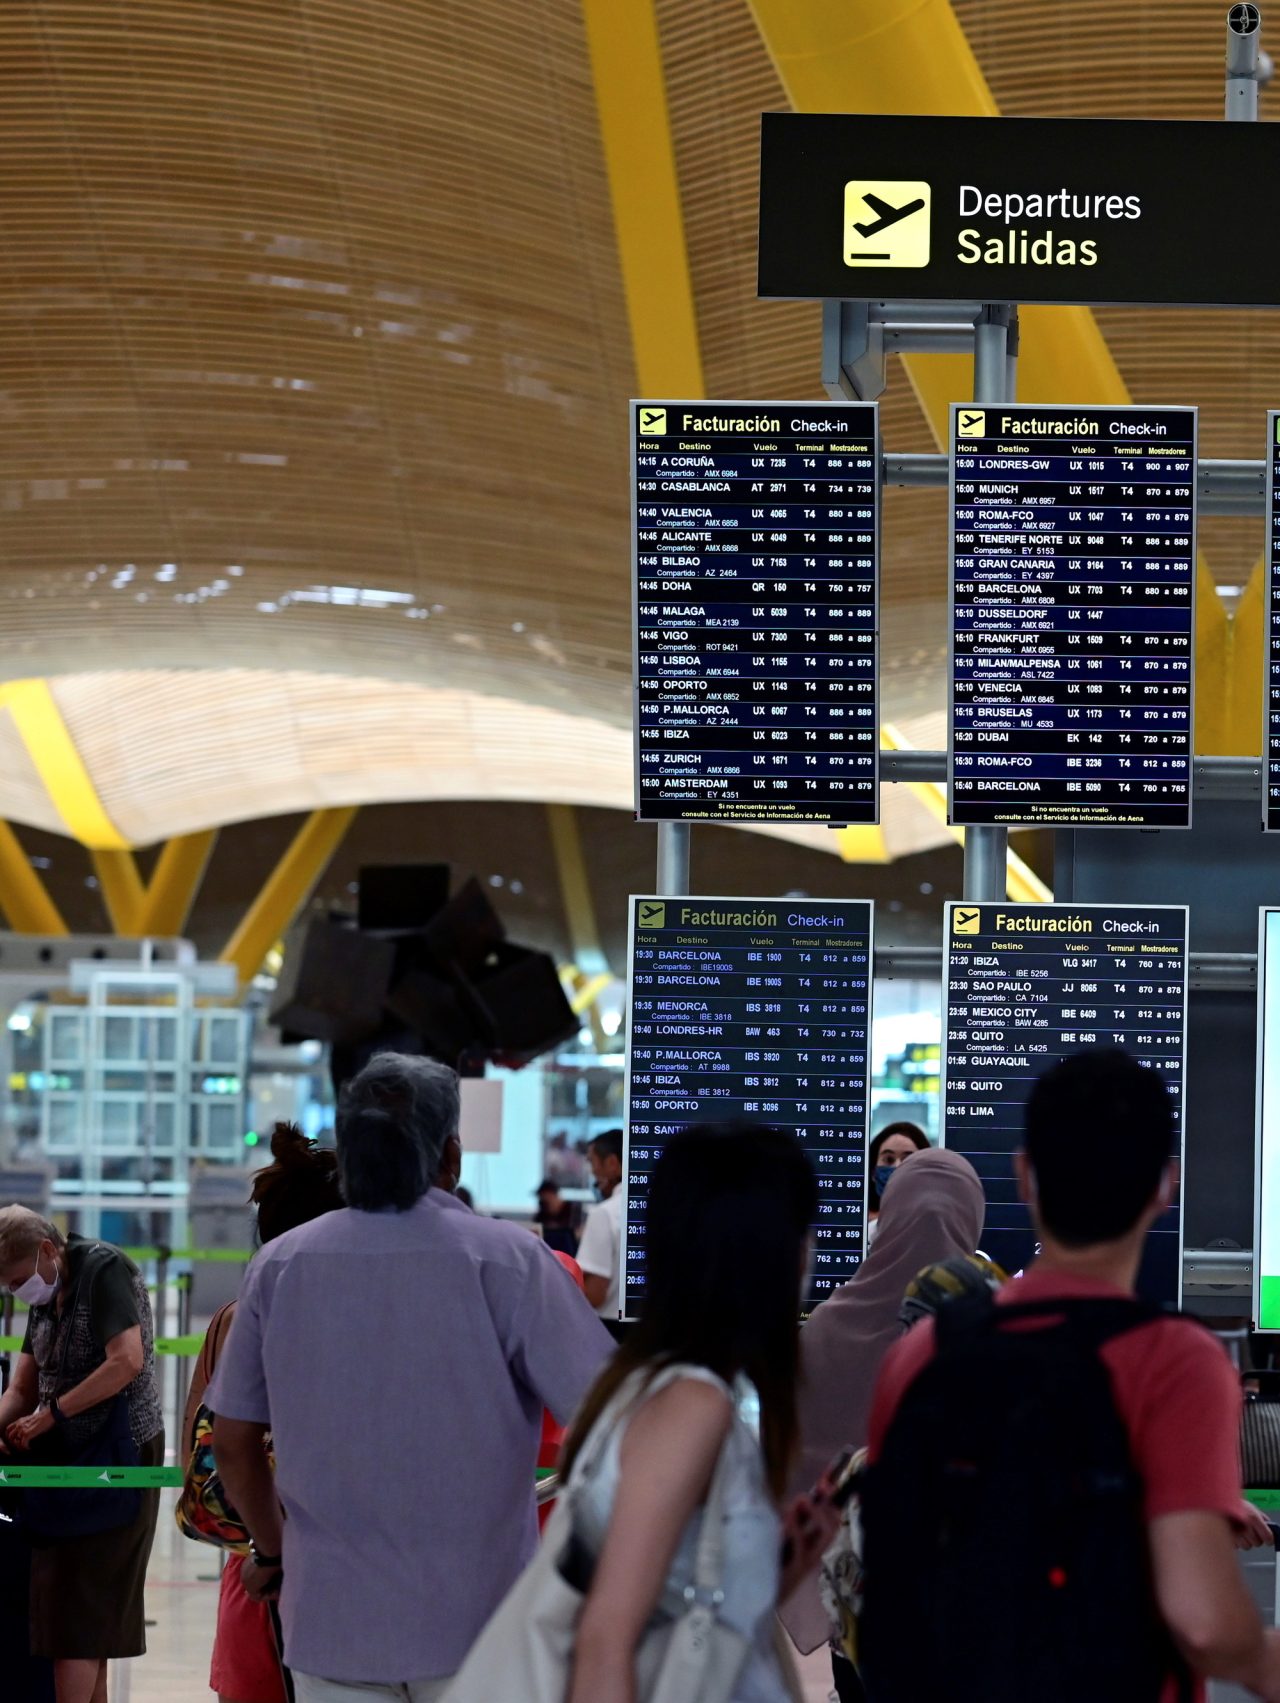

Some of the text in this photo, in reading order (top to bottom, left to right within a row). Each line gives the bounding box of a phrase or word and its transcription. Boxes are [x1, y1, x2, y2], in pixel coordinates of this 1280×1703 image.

[959, 186, 1142, 225] Departures
[957, 229, 1098, 266] Salidas
[683, 415, 848, 432] Facturación Check-in
[1002, 417, 1167, 435] Facturación Check-in
[830, 444, 867, 452] Mostradores
[661, 458, 668, 466] A
[671, 456, 714, 466] CORUÑA
[752, 459, 764, 467] UX
[803, 459, 815, 467] T4
[980, 460, 1049, 469] LONDRES-GW
[656, 470, 695, 478] Compartido
[638, 482, 815, 492] 14:30 CASABLANCA AT 2971 T4
[979, 485, 1018, 494] MUNICH
[662, 508, 712, 517] VALENCIA
[979, 511, 1033, 520] ROMA-FCO
[662, 532, 711, 541] ALICANTE
[979, 535, 1063, 544] TENERIFE NORTE
[662, 557, 700, 566] BILBAO
[979, 559, 1055, 569] GRAN CANARIA
[663, 582, 691, 590] DOHA
[979, 584, 1042, 593] BARCELONA
[663, 607, 705, 615] MALAGA
[979, 609, 1047, 618] DUSSELDORF
[663, 631, 688, 640] VIGO
[978, 634, 1039, 643] FRANKFURT
[663, 656, 701, 665] LISBOA
[978, 659, 1060, 668] MILAN/MALPENSA
[663, 681, 707, 689] OPORTO
[978, 683, 1022, 692] VENECIA
[664, 705, 729, 714] P.MALLORCA
[978, 708, 1032, 717] BRUSELAS
[664, 730, 689, 739] IBIZA
[978, 733, 1008, 741] DUBAI
[664, 754, 701, 763] ZURICH
[978, 757, 1032, 766] ROMA-FCO
[665, 779, 728, 788] AMSTERDAM
[978, 782, 1040, 791] BARCELONA
[681, 908, 844, 927] Facturación Check-in
[996, 914, 1159, 933] Facturación Check-in
[659, 951, 721, 960] BARCELONA
[974, 957, 999, 965] IBIZA
[658, 976, 720, 985] BARCELONA
[973, 982, 1031, 991] SAO PAULO
[658, 1002, 708, 1010] MENORCA
[973, 1008, 1037, 1017] MEXICO CITY
[657, 1026, 722, 1035] LONDRES-HR
[972, 1032, 1003, 1040] QUITO
[656, 1051, 721, 1060] P.MALLORCA
[971, 1057, 1029, 1066] GUAYAQUIL
[655, 1076, 680, 1084] IBIZA
[971, 1081, 1002, 1091] QUITO
[632, 1101, 698, 1110] 19:50 OPORTO
[970, 1107, 994, 1115] LIMA
